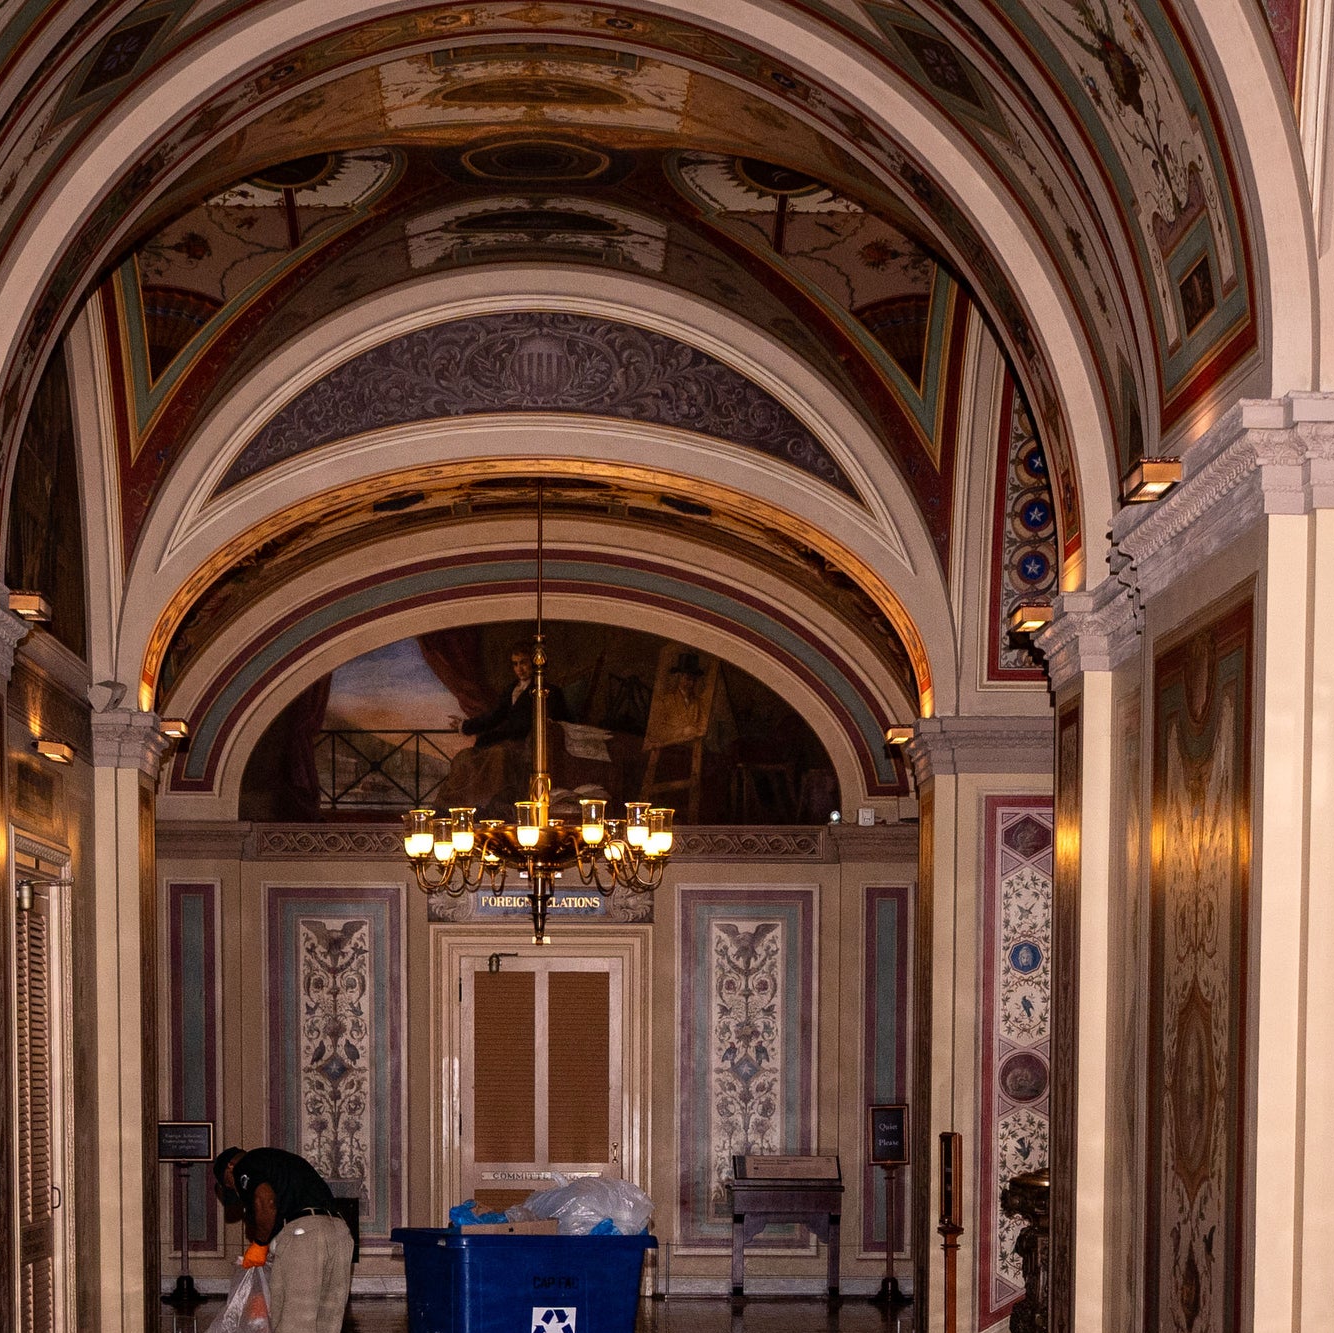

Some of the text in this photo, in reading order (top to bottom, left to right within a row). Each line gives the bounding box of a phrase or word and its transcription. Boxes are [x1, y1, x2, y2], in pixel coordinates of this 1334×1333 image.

[481, 896, 600, 907] FOREIGN ELATIONS
[878, 1123, 898, 1131] Quiet
[493, 1171, 551, 1181] COMMITTE
